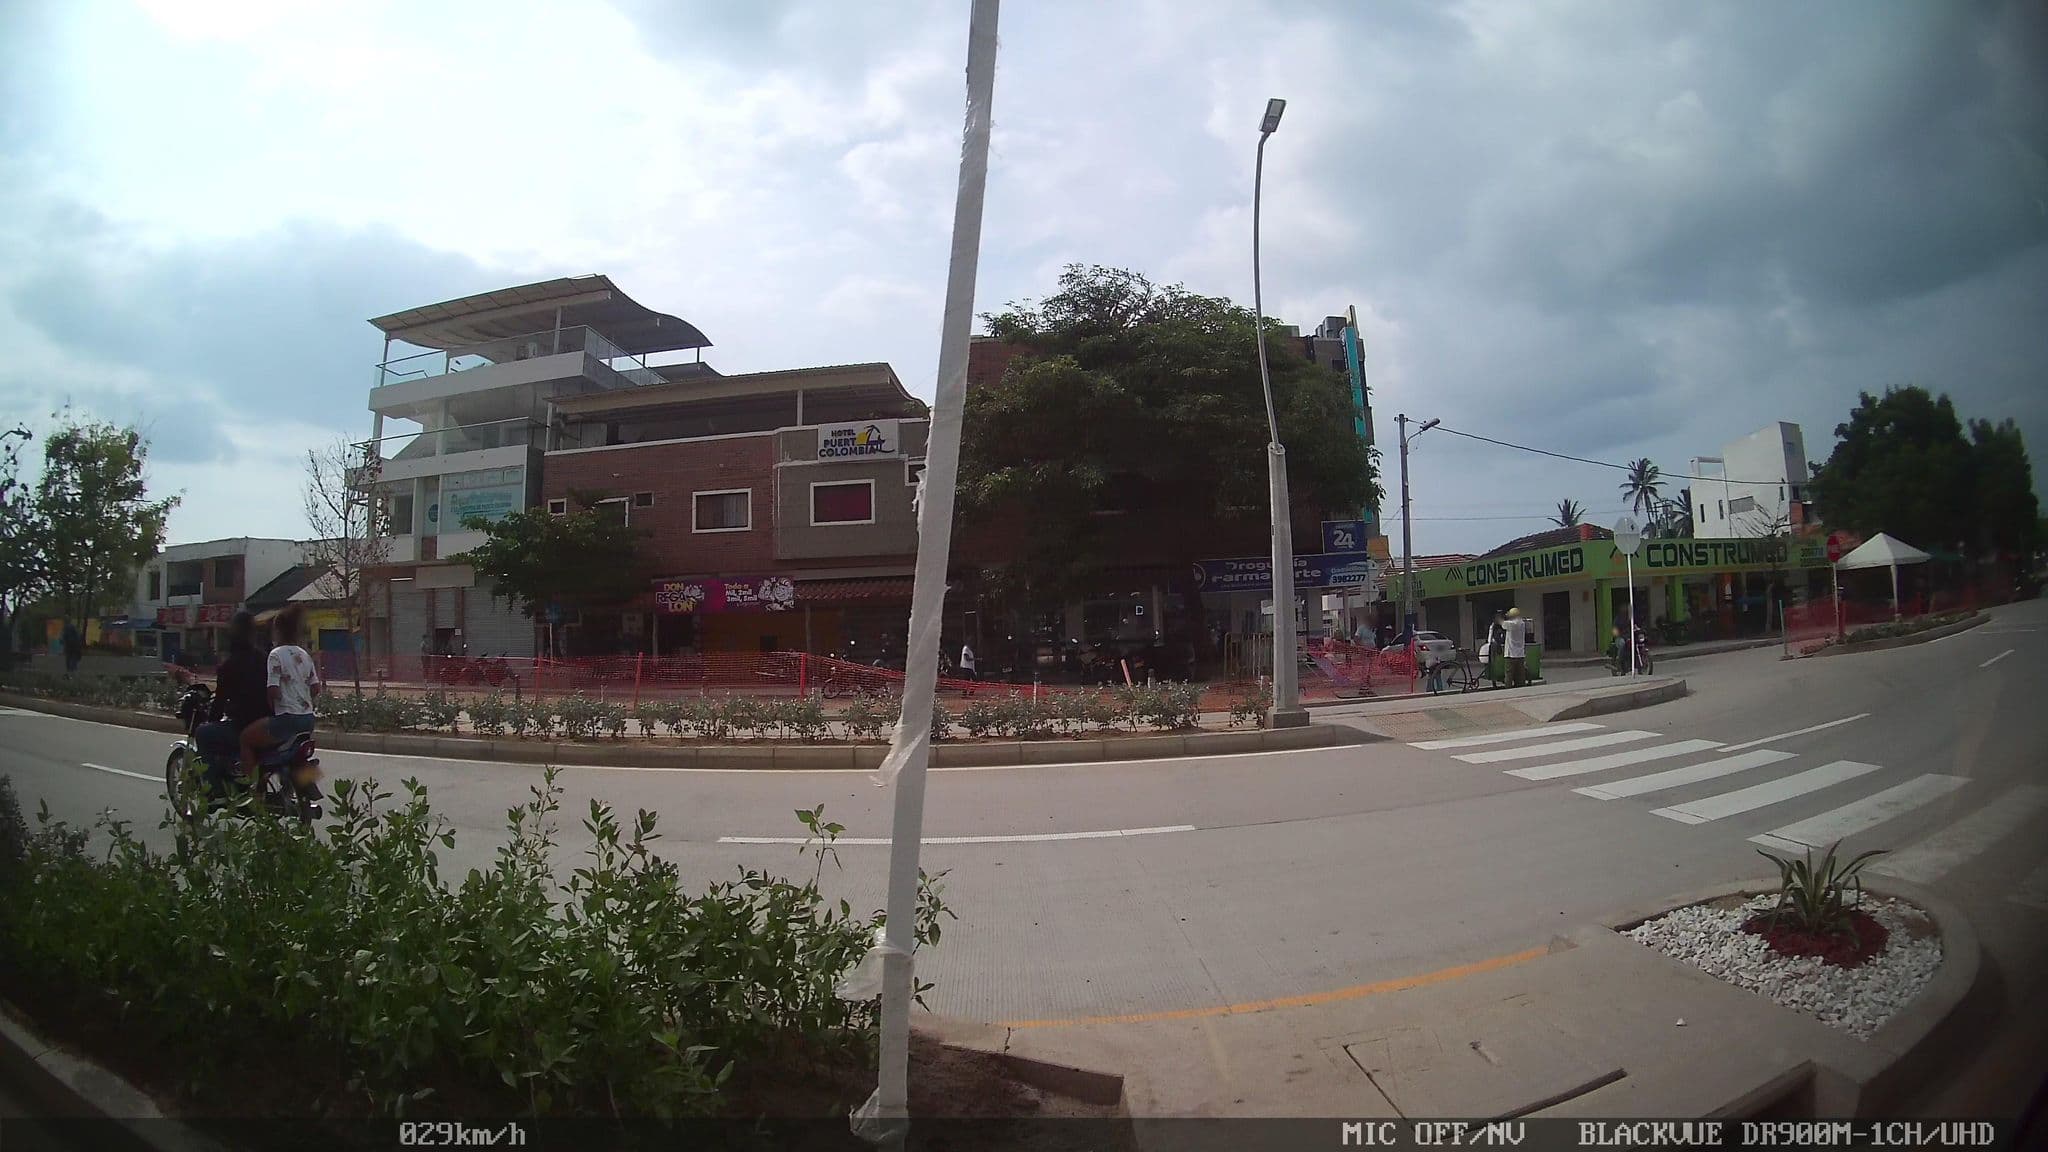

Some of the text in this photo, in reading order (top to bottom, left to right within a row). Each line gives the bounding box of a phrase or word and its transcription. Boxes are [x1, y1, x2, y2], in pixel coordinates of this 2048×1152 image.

[831, 429, 856, 437] HOTEL
[819, 446, 877, 458] COLOMBIA
[1333, 529, 1355, 548] 24
[1646, 543, 1789, 568] CONSTRUMED
[1465, 547, 1585, 587] CONSTRUMED
[663, 583, 684, 592] DON
[668, 600, 697, 613] LON
